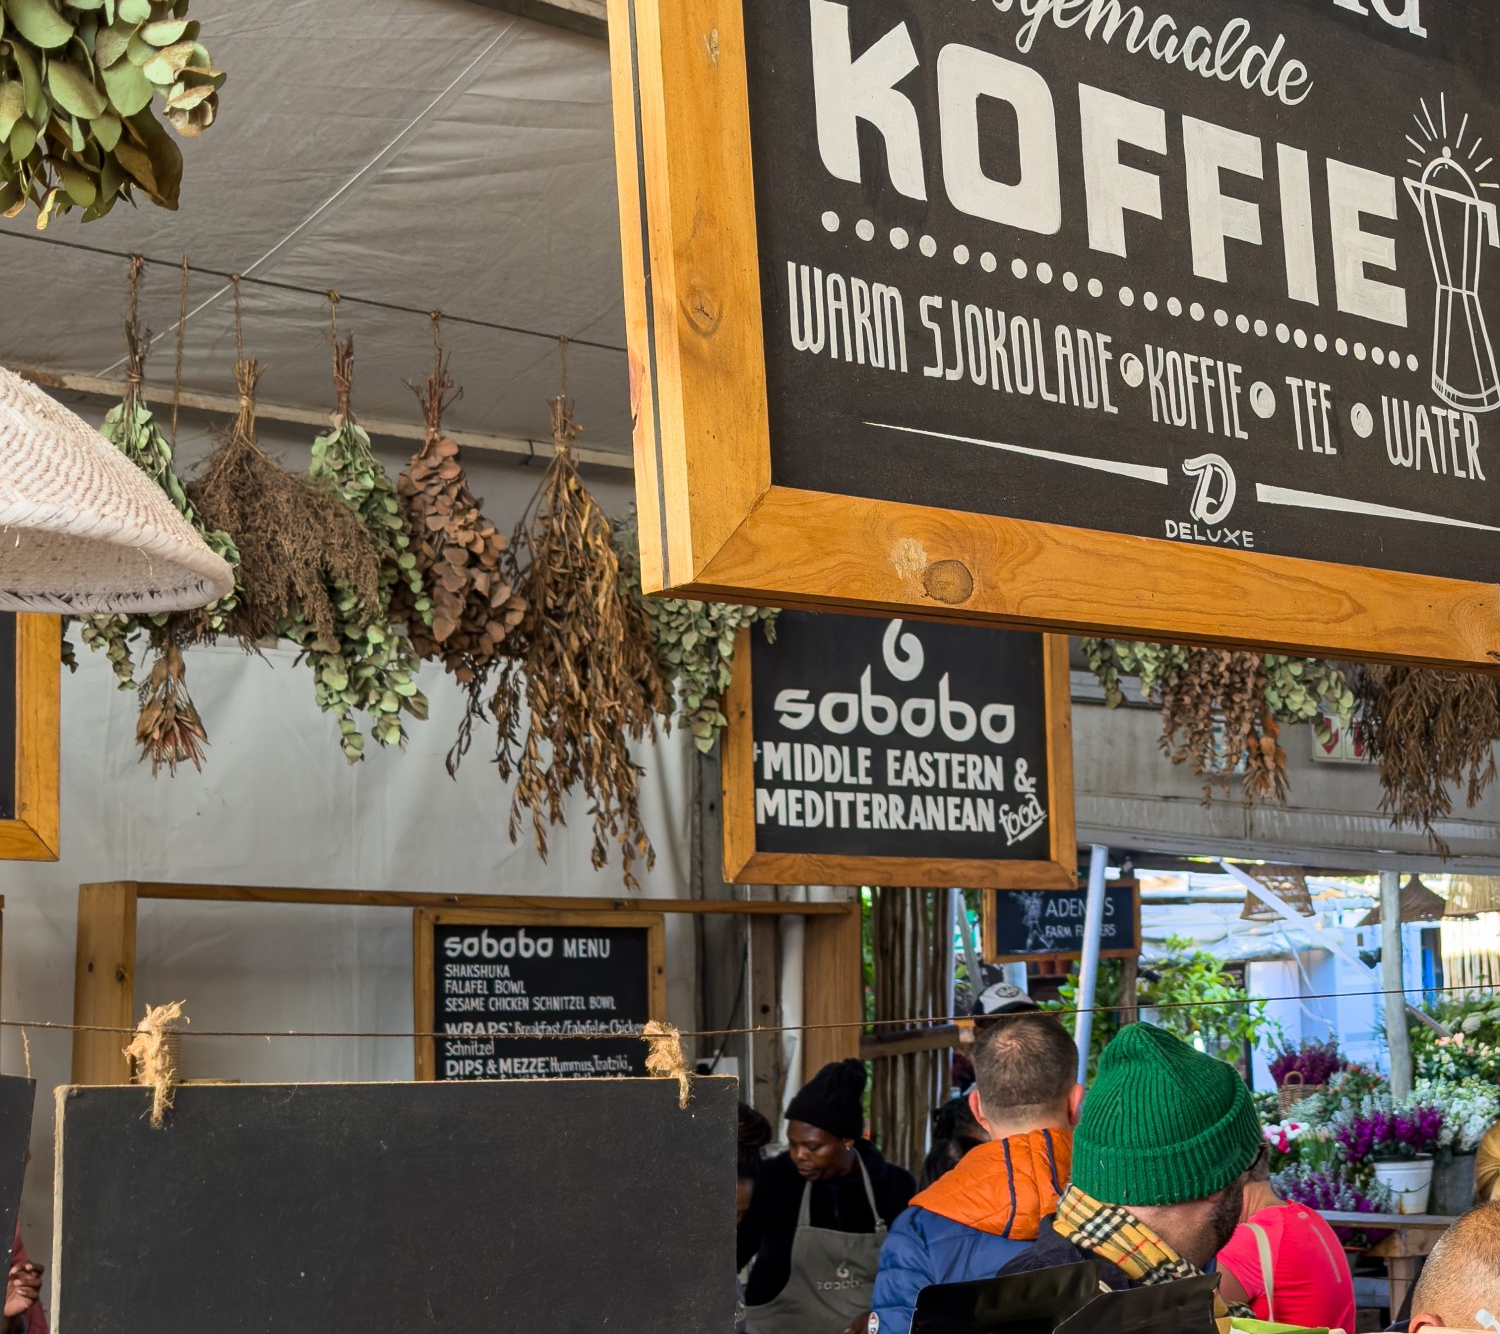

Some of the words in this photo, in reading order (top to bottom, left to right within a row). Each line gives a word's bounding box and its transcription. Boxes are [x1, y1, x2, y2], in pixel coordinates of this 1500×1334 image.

[787, 260, 908, 374] WARM
[923, 293, 1118, 415] SJOKOLADE
[1145, 344, 1249, 440] KOFFIE
[1285, 375, 1338, 456] TEE
[1381, 396, 1487, 482] WATER
[1165, 518, 1256, 549] DELUXE
[762, 741, 873, 786] MIDDLE
[886, 749, 1004, 793] EASTERN
[1014, 757, 1037, 794] &
[755, 788, 996, 833] MEDITERRANEAN
[998, 794, 1046, 846] food
[1045, 925, 1073, 938] FARM
[562, 938, 611, 959] MENU
[444, 964, 511, 979] SHAKSHUKA
[444, 980, 489, 995] FALAFEL
[494, 980, 527, 995] BOWL
[445, 997, 485, 1012] SESAME
[489, 996, 530, 1012] CHICKEN
[532, 996, 586, 1011] SCHNITZEL
[589, 996, 617, 1011] BOWL
[444, 1041, 495, 1057] Schnitzel
[445, 1060, 484, 1077] DIPS
[486, 1060, 498, 1075] &
